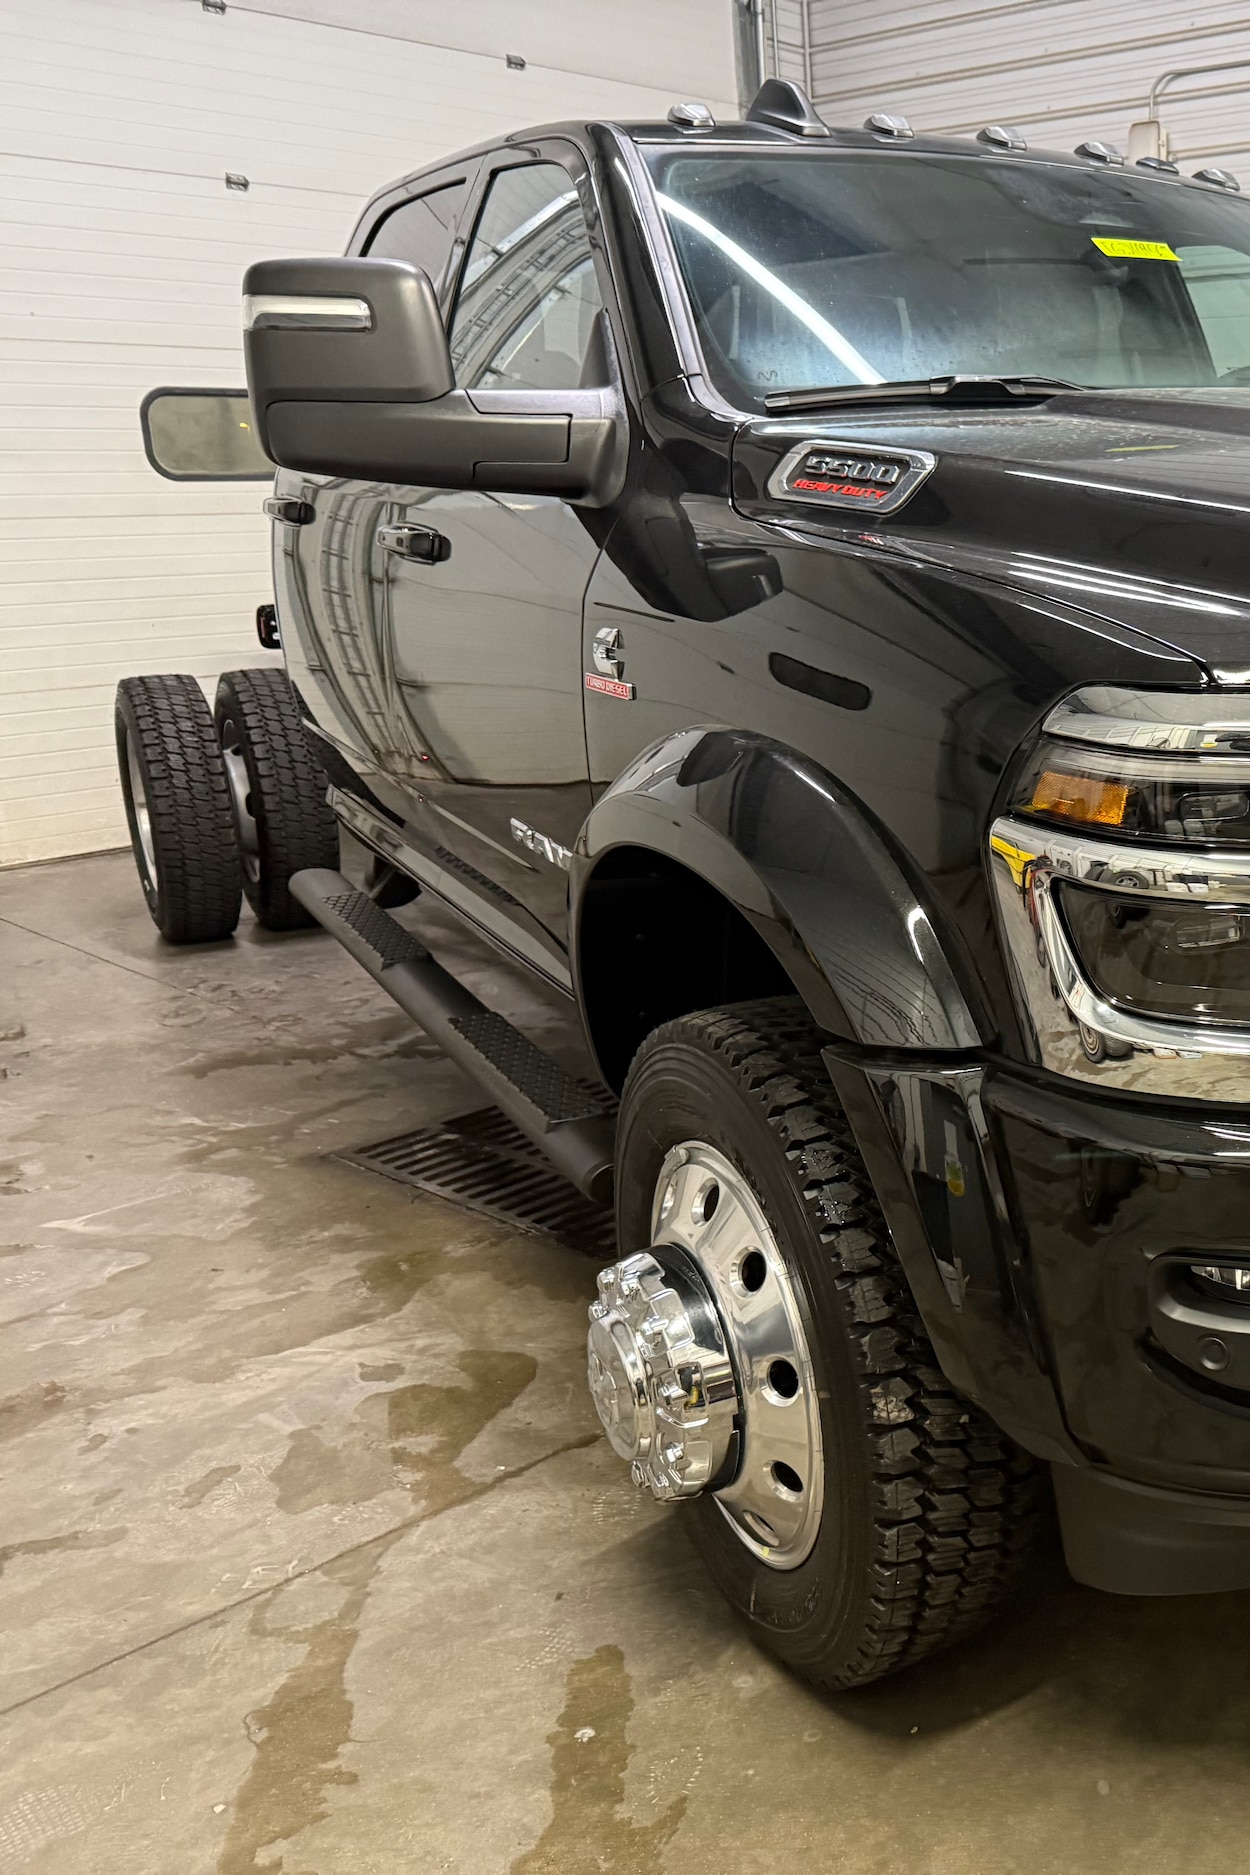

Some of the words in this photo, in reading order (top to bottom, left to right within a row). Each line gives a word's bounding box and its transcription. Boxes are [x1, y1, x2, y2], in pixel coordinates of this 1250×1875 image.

[805, 455, 900, 485] 5500
[792, 479, 843, 493] HEAVY
[841, 485, 888, 499] DUTY
